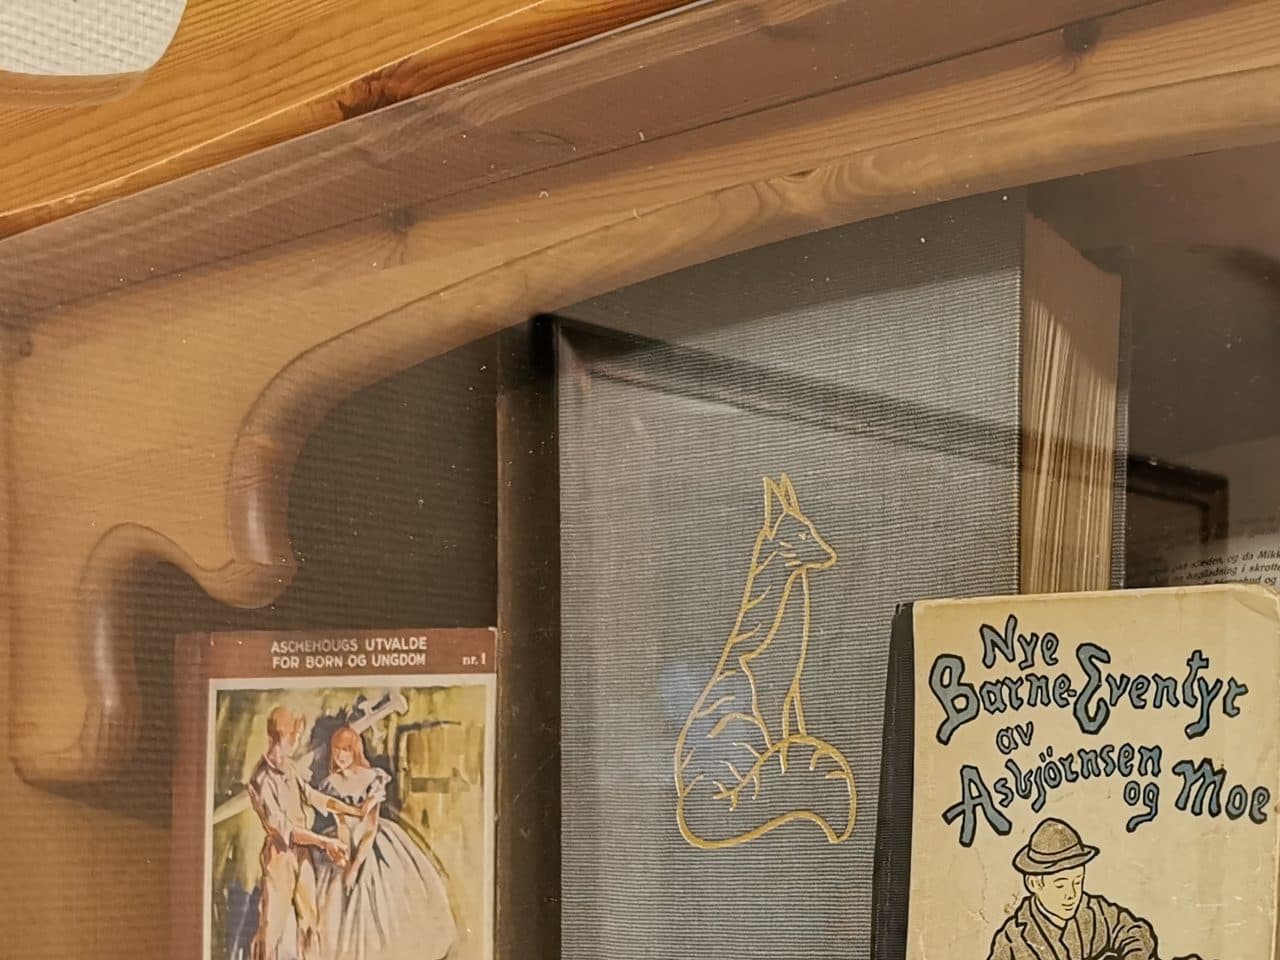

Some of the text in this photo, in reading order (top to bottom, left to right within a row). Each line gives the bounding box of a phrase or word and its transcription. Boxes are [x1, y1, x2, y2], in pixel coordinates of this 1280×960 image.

[271, 636, 428, 654] ASCHEHOUGS UTVALDE
[979, 613, 1060, 670] Nye
[272, 656, 299, 669] FOR
[348, 654, 367, 667] OG
[372, 653, 426, 667] UNGDOM
[462, 655, 478, 665] nr.
[996, 721, 1034, 754] av
[1123, 758, 1271, 833] og Moe
